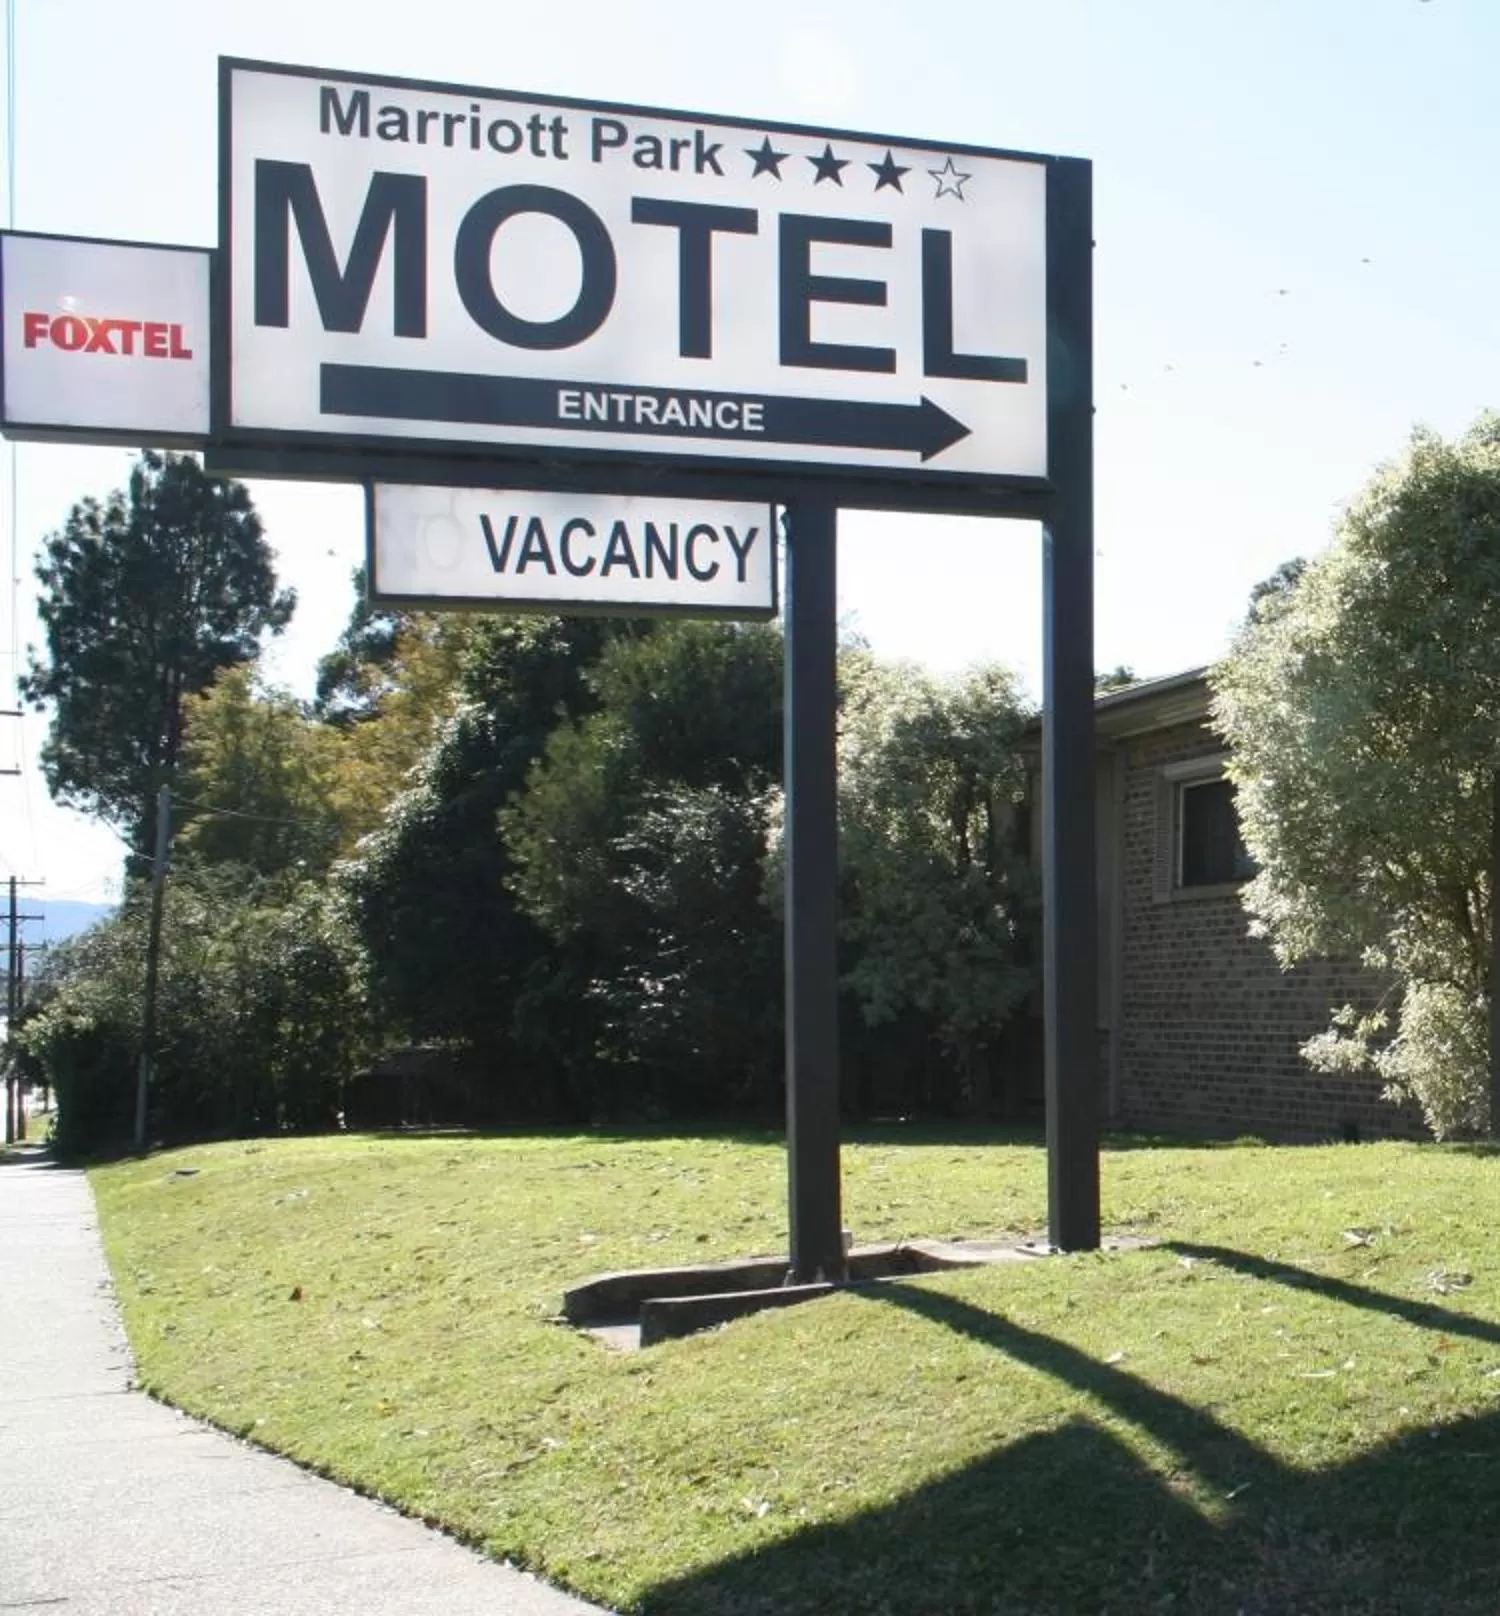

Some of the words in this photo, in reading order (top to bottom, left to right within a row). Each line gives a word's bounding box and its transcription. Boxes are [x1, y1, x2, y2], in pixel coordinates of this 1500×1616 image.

[319, 85, 570, 159] Marriott
[590, 117, 725, 175] Park
[254, 158, 1028, 384] MOTEL
[23, 312, 193, 360] FOXTEL
[558, 390, 764, 432] ENTRANCE
[480, 513, 760, 583] VACANCY
